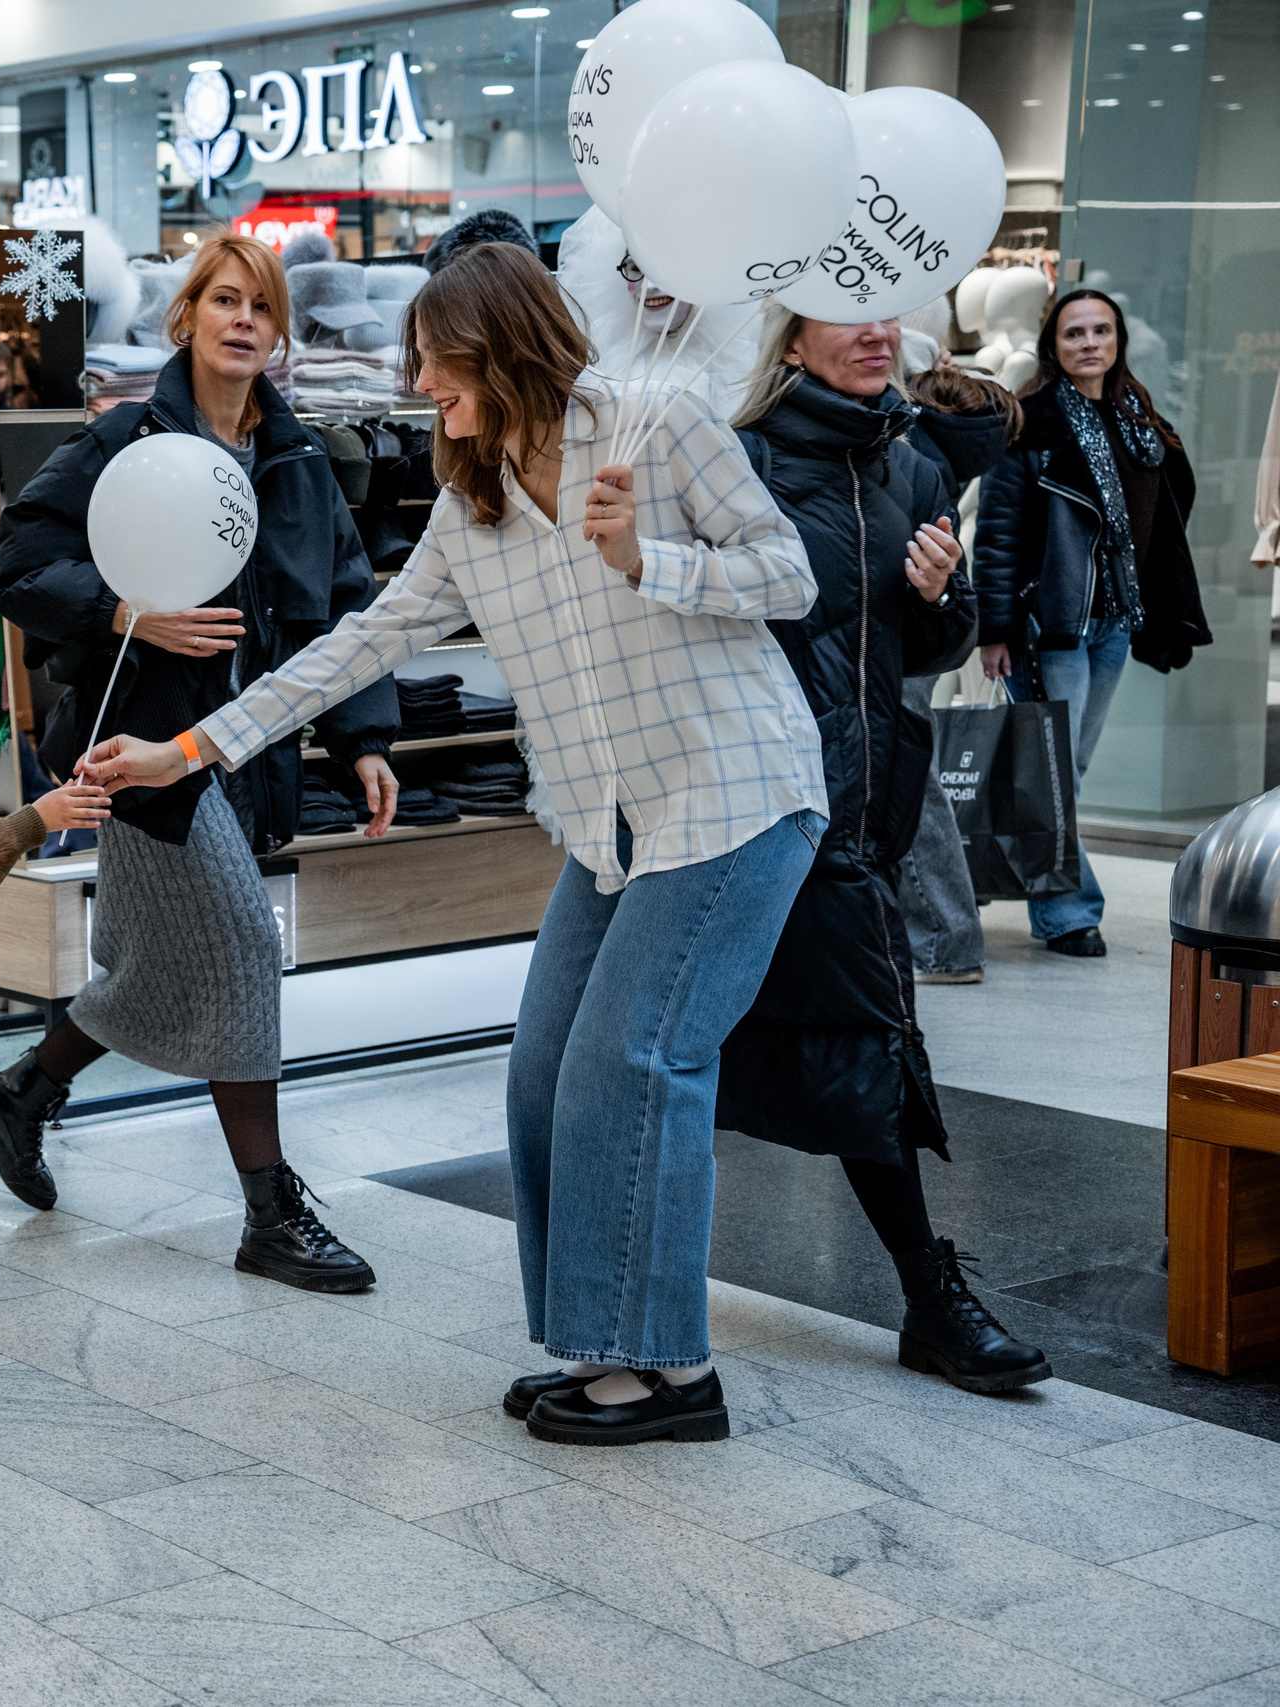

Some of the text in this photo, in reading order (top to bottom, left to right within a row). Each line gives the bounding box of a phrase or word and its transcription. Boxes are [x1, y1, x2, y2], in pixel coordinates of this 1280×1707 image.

[572, 63, 613, 95] LIN'S
[247, 51, 427, 163] ЭПЛ
[843, 222, 902, 286] КИДКА
[219, 495, 255, 533] СКИДКА
[211, 517, 249, 559] -20%
[943, 787, 977, 801] ОРОЛЕВА
